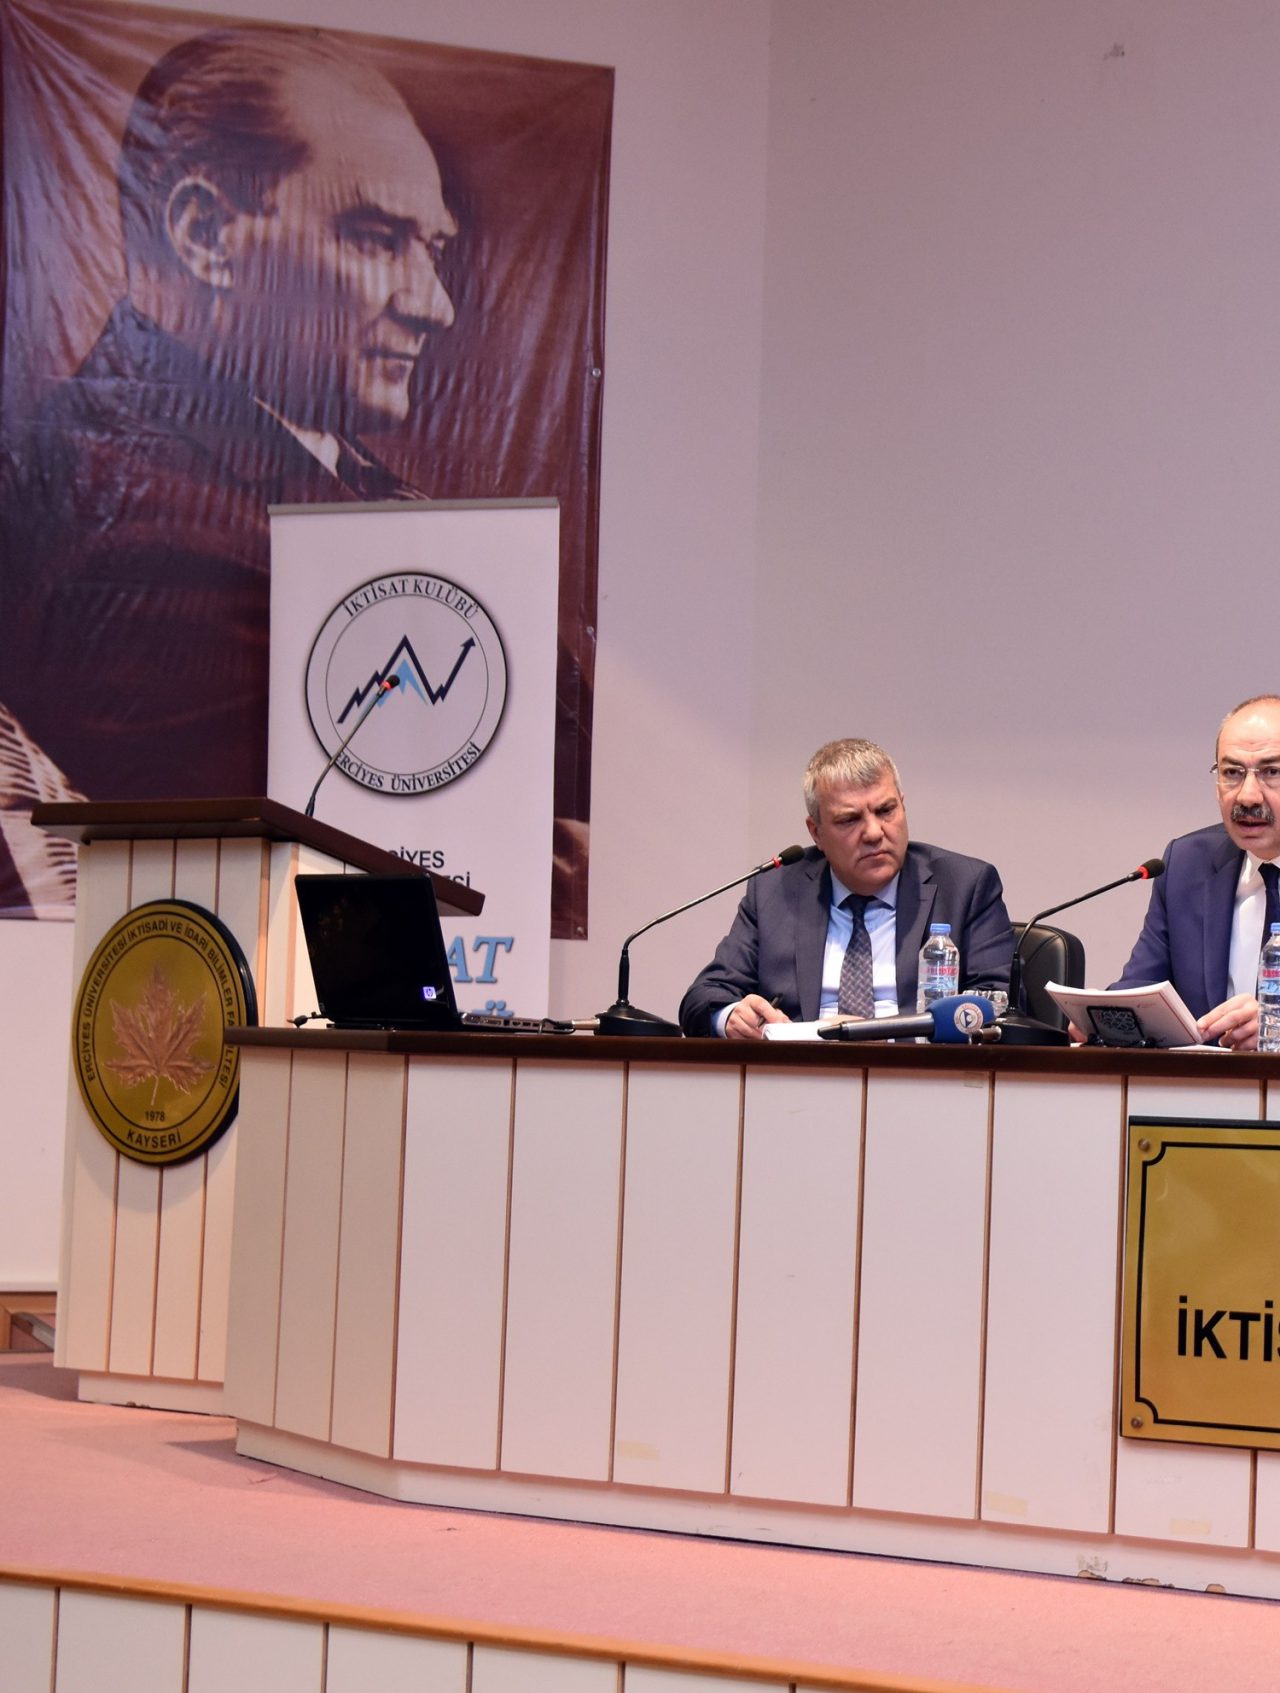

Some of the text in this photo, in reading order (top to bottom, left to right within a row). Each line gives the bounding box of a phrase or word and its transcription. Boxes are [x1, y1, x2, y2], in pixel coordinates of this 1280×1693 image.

[343, 578, 479, 620] İKTİSAT KULÜBÜ
[391, 741, 482, 791] ÜNİVERSİTESİ
[82, 919, 235, 1089] ERCİYES ÜNİVERSİTESİ İKTİSADİ VE İDARİ BİLİMLER FALTESİ
[145, 1110, 165, 1122] 1978
[127, 1128, 181, 1149] KAYSERİ
